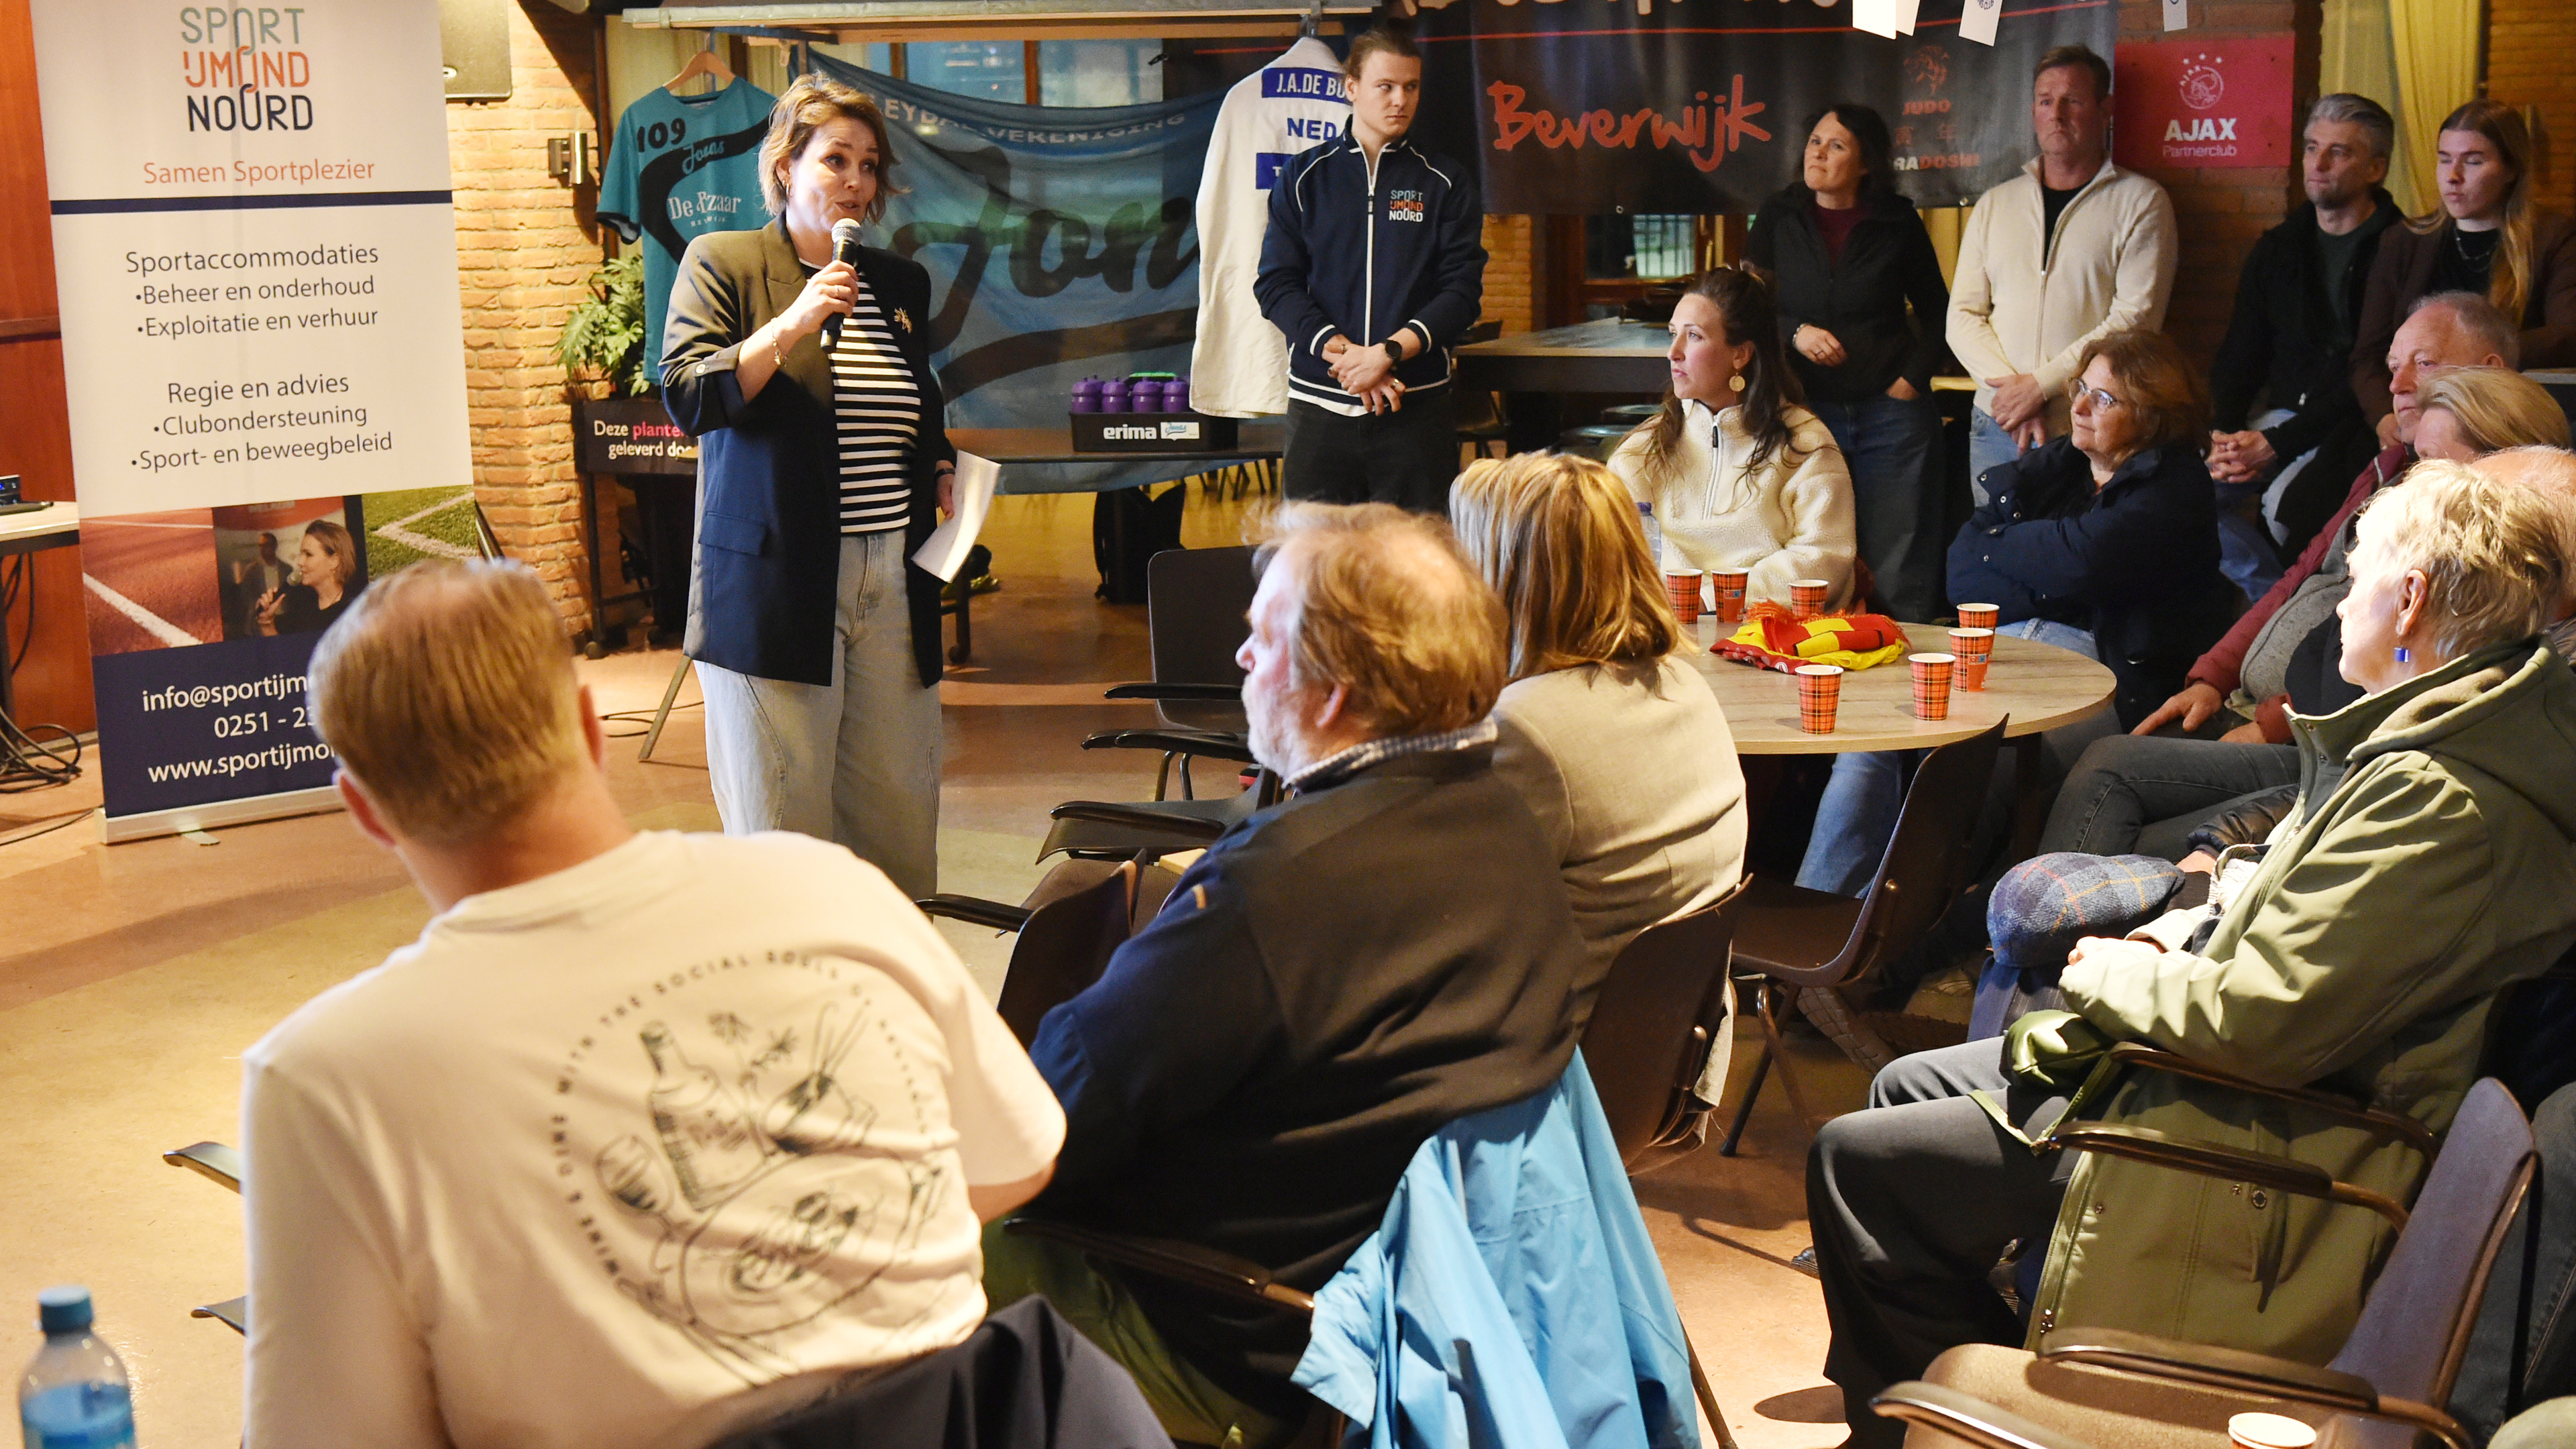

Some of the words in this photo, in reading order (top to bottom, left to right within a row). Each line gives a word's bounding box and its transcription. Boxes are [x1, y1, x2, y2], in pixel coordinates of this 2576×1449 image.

[179, 7, 305, 56] SPORT
[186, 83, 314, 132] NOORD
[1902, 99, 1951, 115] JUDO
[637, 117, 686, 153] 109
[1287, 117, 1337, 141] NED
[1486, 73, 1772, 172] Beverwijk
[2164, 117, 2237, 142] AJAX
[2162, 144, 2238, 158] Partnerclub
[143, 162, 227, 184] Samen
[233, 158, 375, 187] Sportplezier
[667, 197, 694, 220] De
[1390, 189, 1424, 202] SPORT
[1389, 208, 1424, 223] NOORD
[125, 244, 379, 278] Sportaccommodaties
[143, 283, 219, 305] Beheer
[225, 286, 252, 301] en
[258, 275, 375, 299] onderhoud
[145, 314, 260, 340] Exploitatie
[266, 315, 292, 330] en
[297, 308, 379, 328] verhuur
[168, 380, 234, 408] Regie
[241, 382, 270, 398] en
[276, 374, 350, 396] advies
[163, 405, 368, 437] Clubondersteuning
[593, 419, 629, 437] Deze
[1103, 423, 1157, 440] erima
[140, 448, 207, 474] Sport-
[213, 448, 239, 464] en
[246, 431, 393, 462] beweegbeleid
[608, 439, 664, 460] geleverd
[213, 711, 269, 739] 0251
[653, 953, 749, 996] SOCIAL
